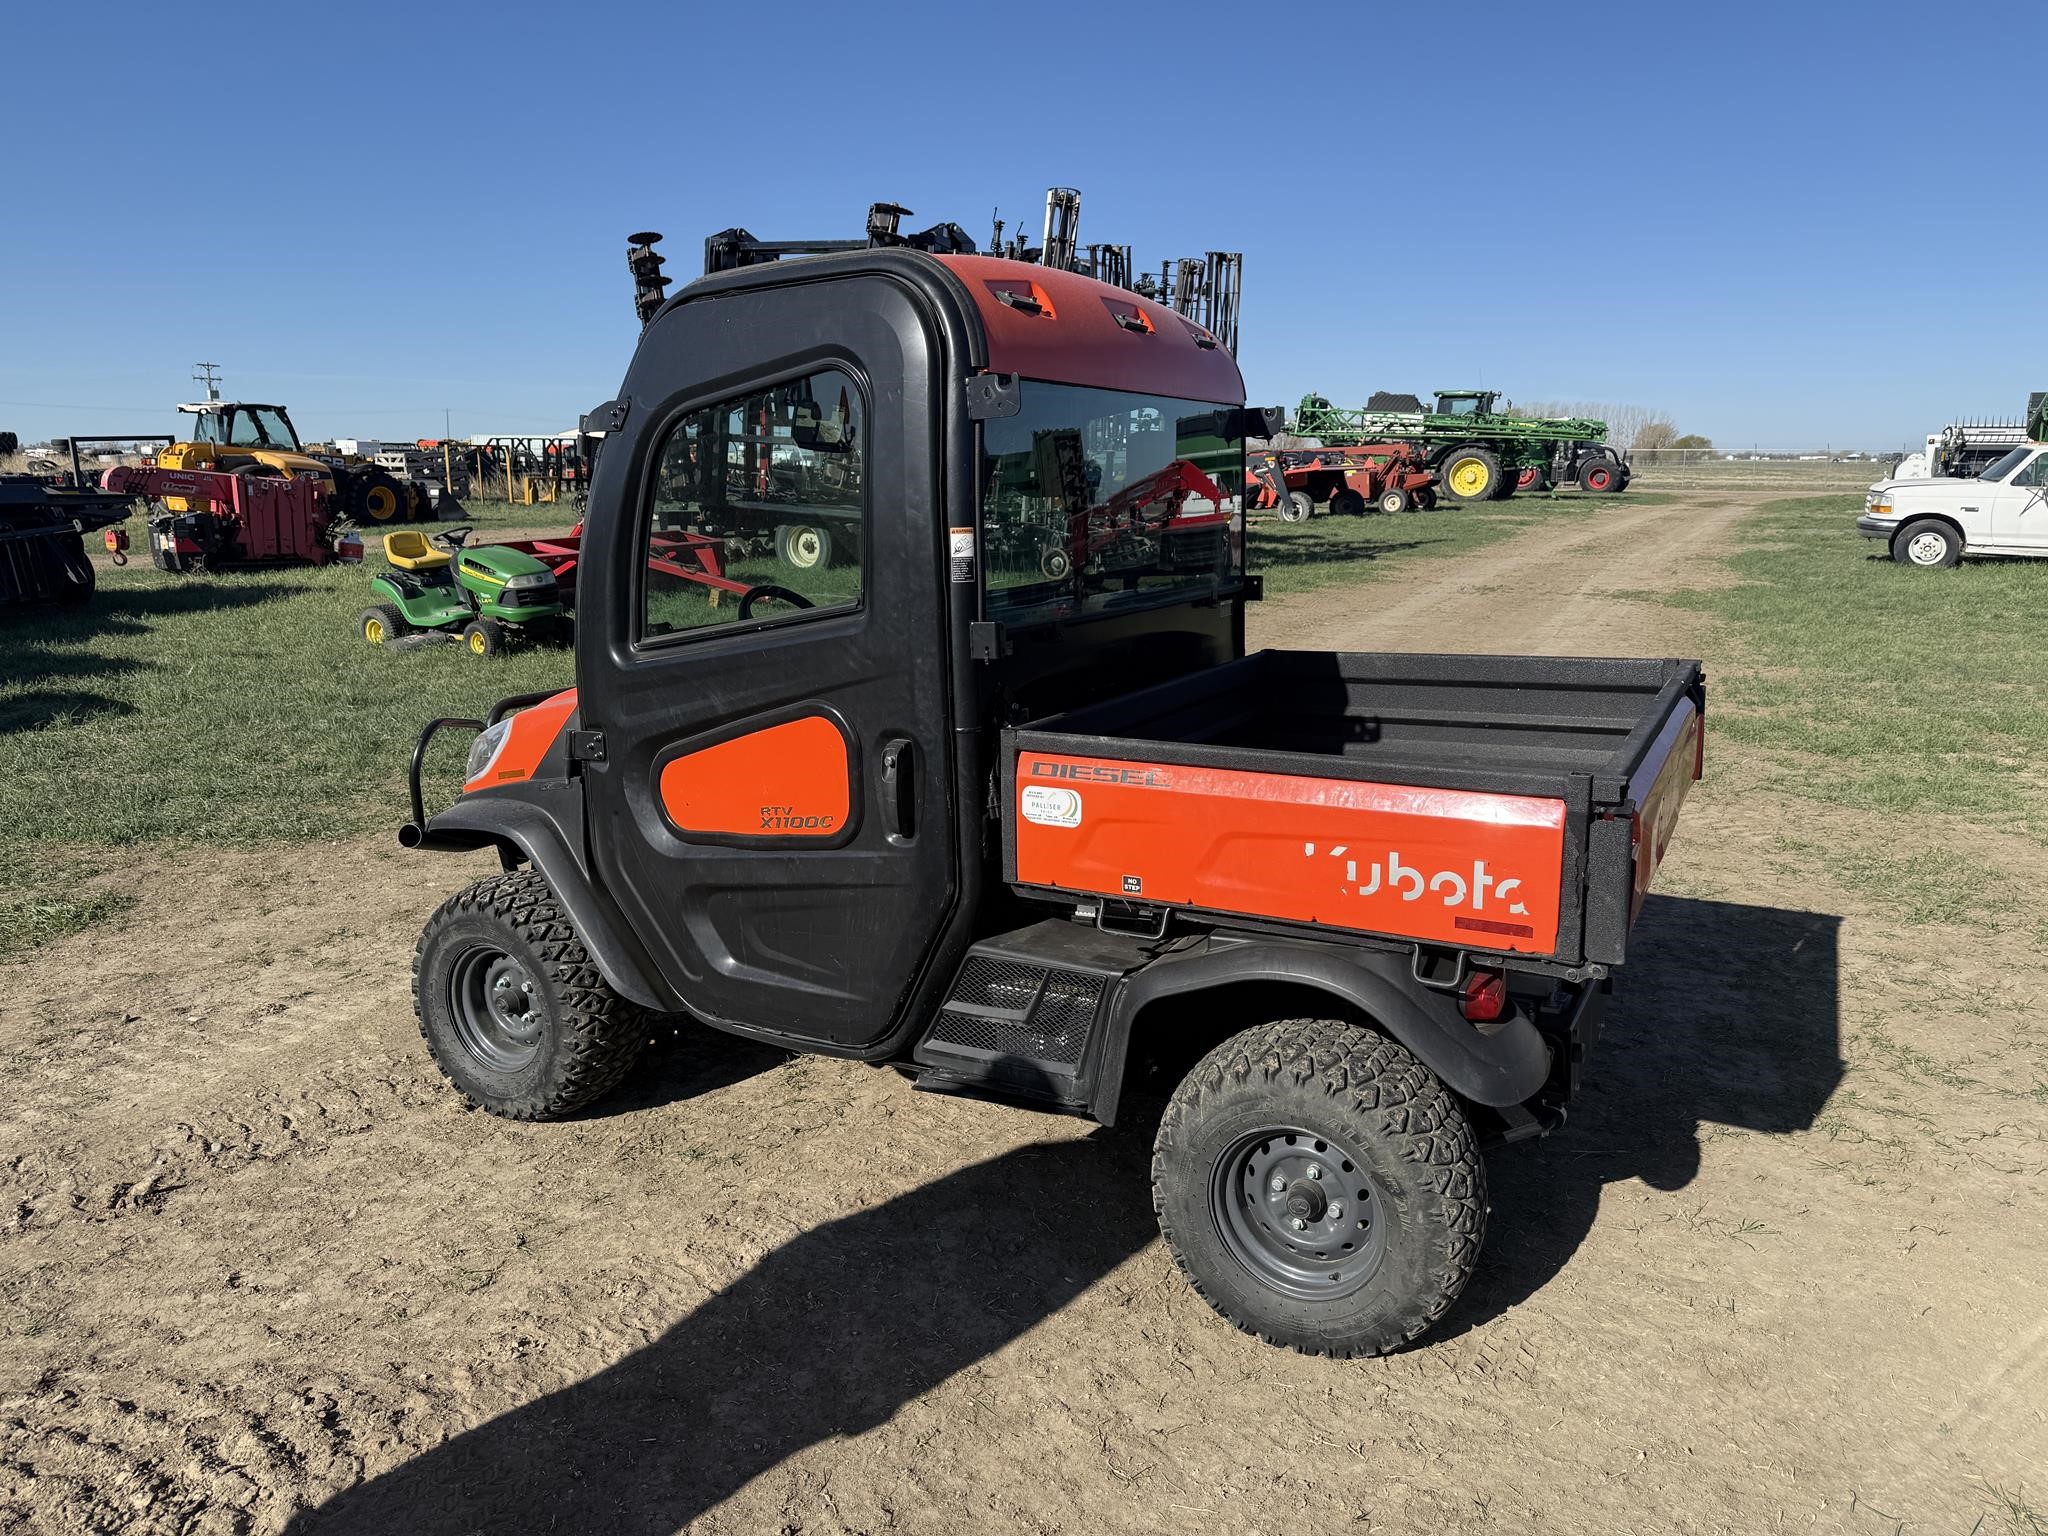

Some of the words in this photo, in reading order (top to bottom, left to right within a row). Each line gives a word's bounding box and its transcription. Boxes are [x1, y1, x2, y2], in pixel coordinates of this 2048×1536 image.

[169, 472, 195, 481] UNIC
[1031, 761, 1170, 788] DIESEL
[760, 806, 793, 816] RTV
[760, 815, 834, 829] X1100C
[1304, 842, 1530, 916] ubota
